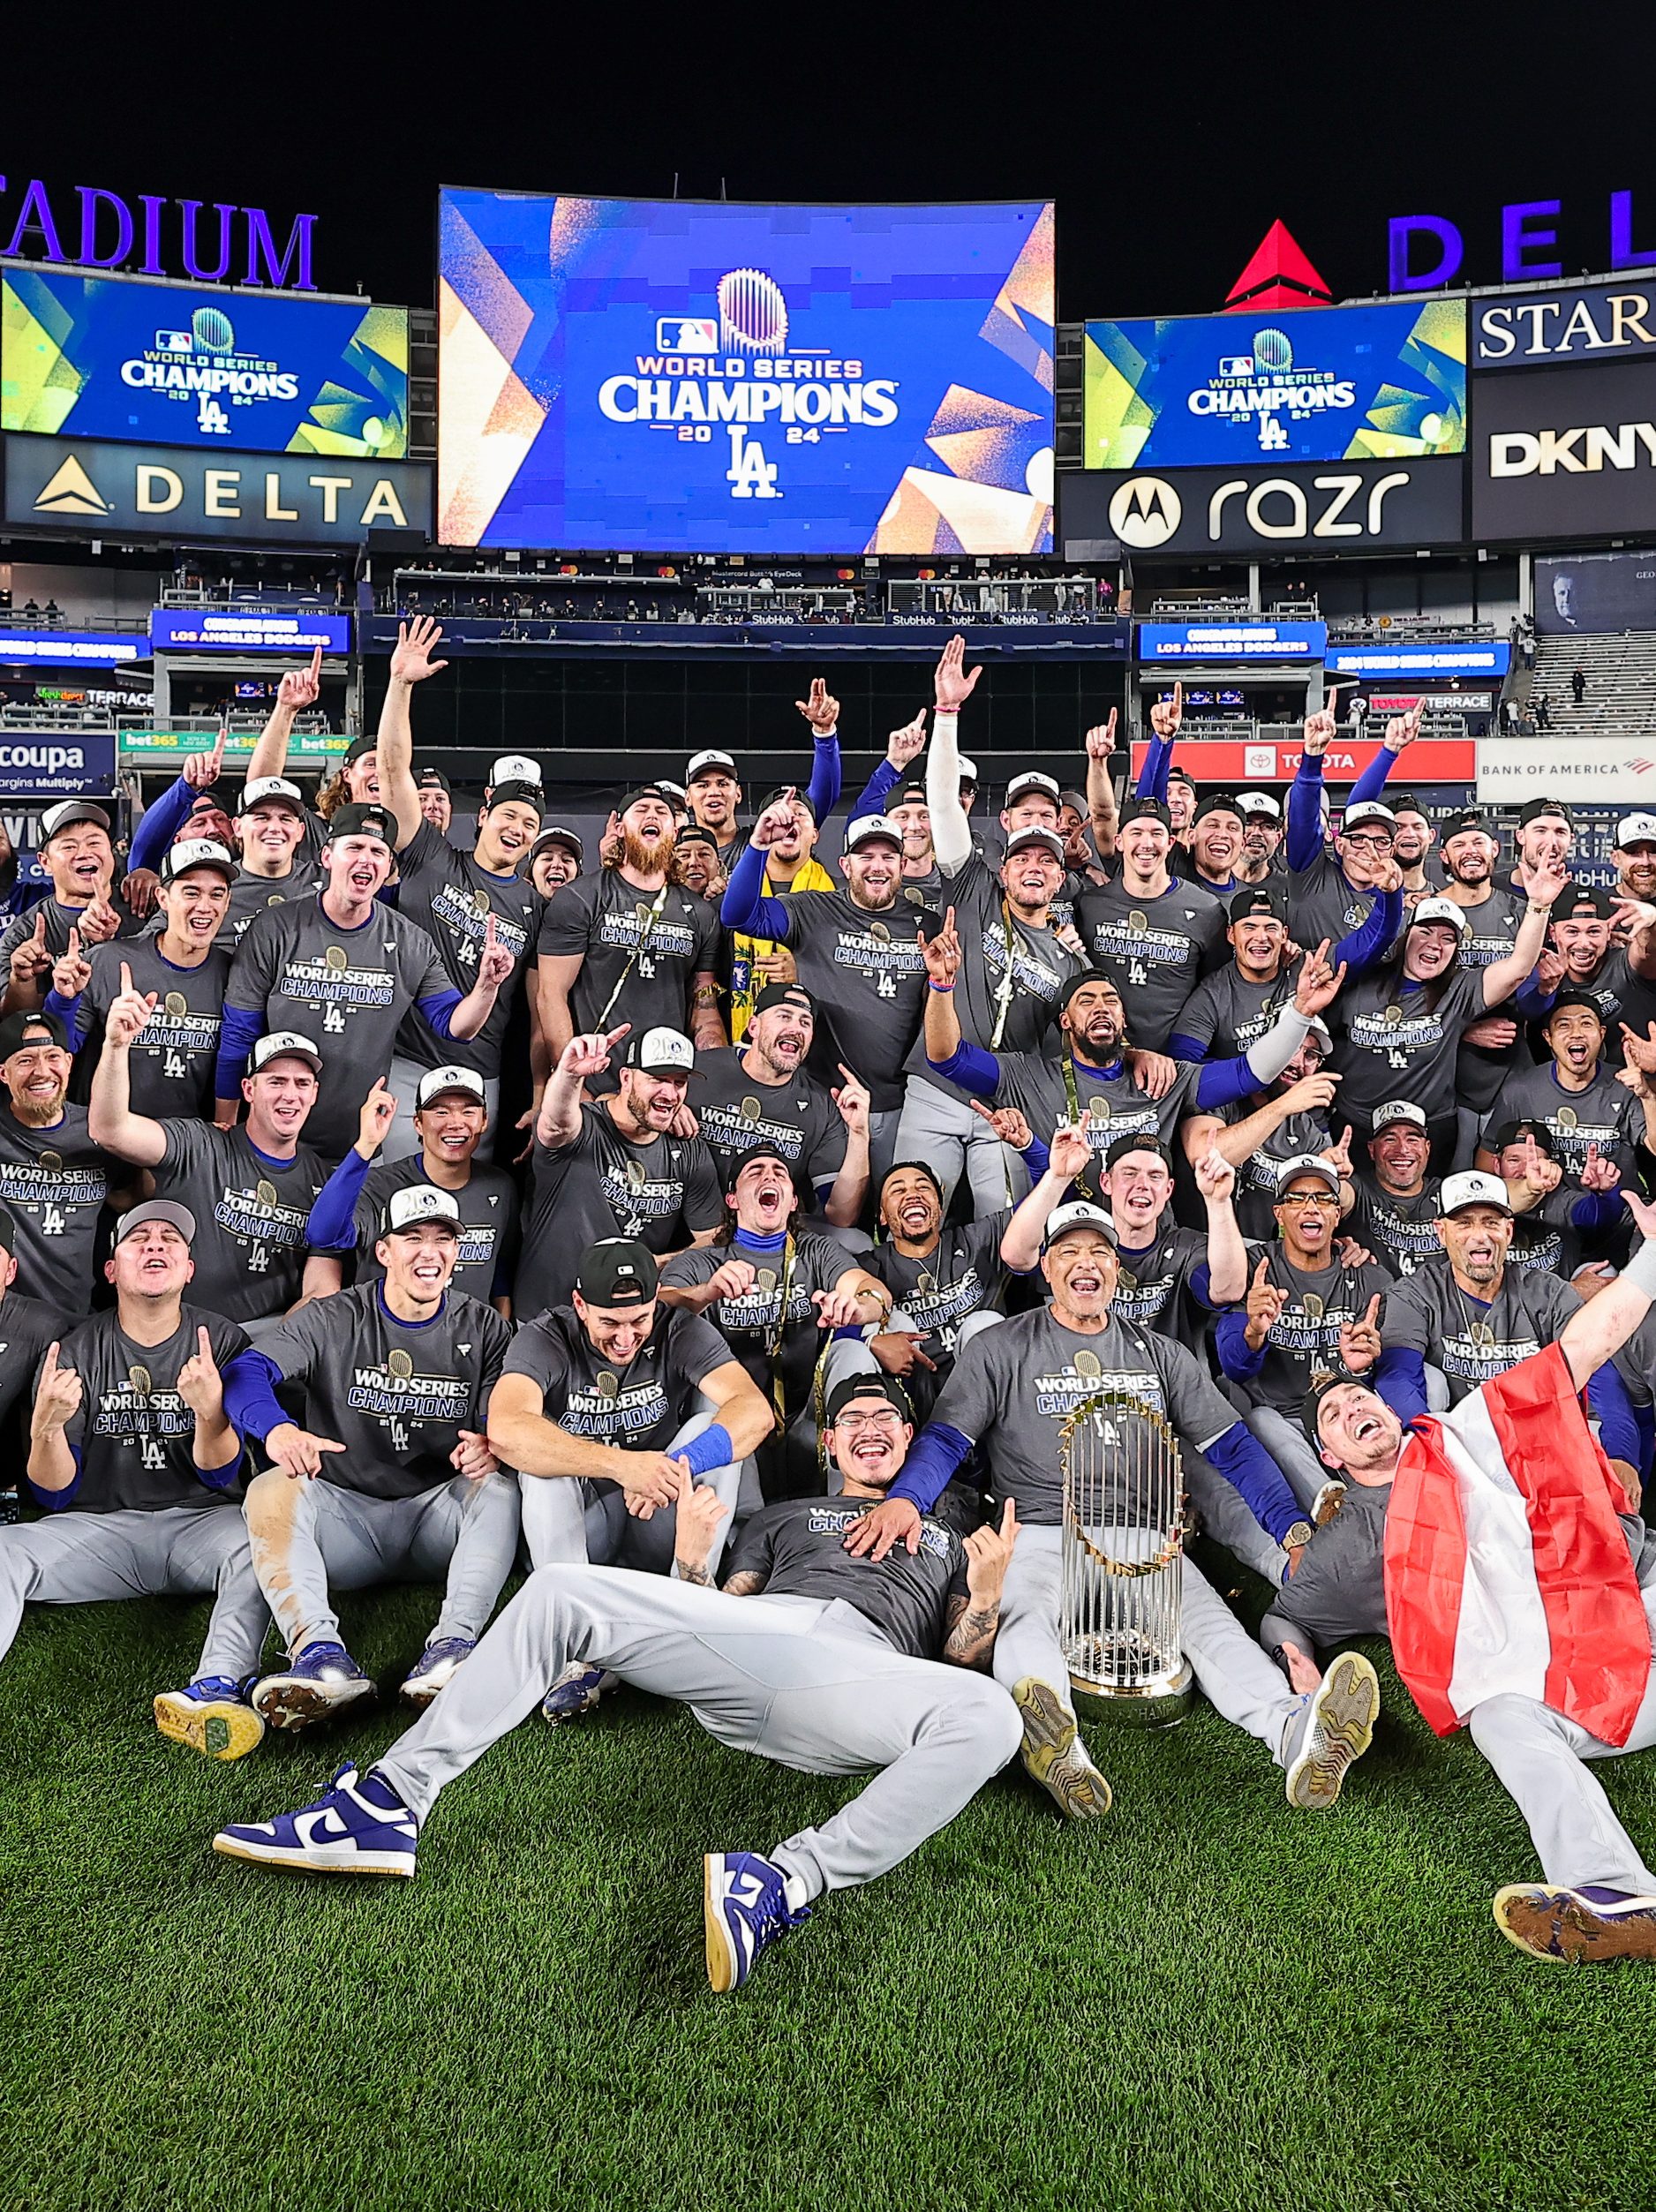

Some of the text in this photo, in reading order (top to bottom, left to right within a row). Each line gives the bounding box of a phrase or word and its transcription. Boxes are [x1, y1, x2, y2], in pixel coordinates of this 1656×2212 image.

[0, 175, 319, 291] ADIUM
[143, 350, 277, 372] WORLD SERIES
[636, 356, 862, 380] WORLD SERIES
[120, 359, 299, 400] CHAMPIONS
[1208, 372, 1335, 388] WORLD SERIES
[168, 389, 253, 406] 20 24
[598, 376, 900, 425] CHAMPIONS
[1188, 380, 1356, 416] CHAMPIONS
[1291, 410, 1311, 419] 24
[677, 425, 821, 444] 20 24
[726, 425, 783, 498] LA
[136, 463, 409, 527] DELTA
[1208, 472, 1410, 540] razr
[752, 613, 794, 625] StubHub
[892, 615, 936, 625] StubHub
[170, 631, 197, 642] LOS
[1156, 643, 1181, 653] LOS
[87, 689, 155, 707] TERRACE
[1371, 696, 1490, 710] TOYOT TERRACE
[125, 734, 178, 748] bet365
[301, 738, 350, 750] bet365
[0, 745, 84, 775] coupa
[1282, 753, 1356, 769] TOOTA
[1482, 764, 1619, 775] BANK OF AMERICA
[442, 883, 485, 922] WORLD
[651, 922, 695, 941] SERIES
[838, 932, 922, 955] WORLD SERIE
[1096, 924, 1191, 948] WORLD SERIES
[456, 933, 478, 967] LA
[1093, 936, 1189, 964] CHAMPIONS
[1472, 938, 1515, 952] SERIES
[285, 963, 395, 988] WORLD SERIES
[877, 969, 897, 997] LA
[1022, 956, 1061, 989] SERIES
[1128, 958, 1148, 985] LA
[280, 977, 394, 1006] CHAMPIONS
[323, 1001, 346, 1034] LA
[1353, 1012, 1442, 1032] WORLD SERIES
[132, 1027, 218, 1050] HAMPION
[1351, 1024, 1444, 1049] CHAMPIONS
[162, 1047, 186, 1079] LA
[1387, 1046, 1410, 1069] LA
[700, 1105, 805, 1144] WORLD SERIES
[1110, 1109, 1158, 1131] SERIES
[1575, 1126, 1621, 1141] SERIES
[0, 1163, 106, 1185] WORLD SERIES
[1563, 1152, 1584, 1176] LA
[0, 1179, 106, 1202] CHAMPIONS
[600, 1176, 682, 1215] CHAMPIONS
[641, 1182, 684, 1199] SERIES
[42, 1201, 65, 1235] LA
[237, 1238, 248, 1246] 20
[1369, 1217, 1447, 1253] CHAMPION
[247, 1238, 270, 1273] LA
[915, 1279, 985, 1330] AMPIONS
[1268, 1324, 1342, 1350] CHAMPIO
[409, 1377, 472, 1398] SERIES
[1034, 1373, 1161, 1394] WORLD SERIES
[99, 1394, 148, 1412] WORLD
[347, 1387, 469, 1418] CHAMPIONS
[567, 1381, 665, 1413] WORLD SERIES
[558, 1396, 669, 1435] CHAMPIONS
[123, 1438, 135, 1447] 20
[388, 1414, 410, 1452] LA
[626, 1434, 638, 1444] 24
[139, 1433, 168, 1470] LA
